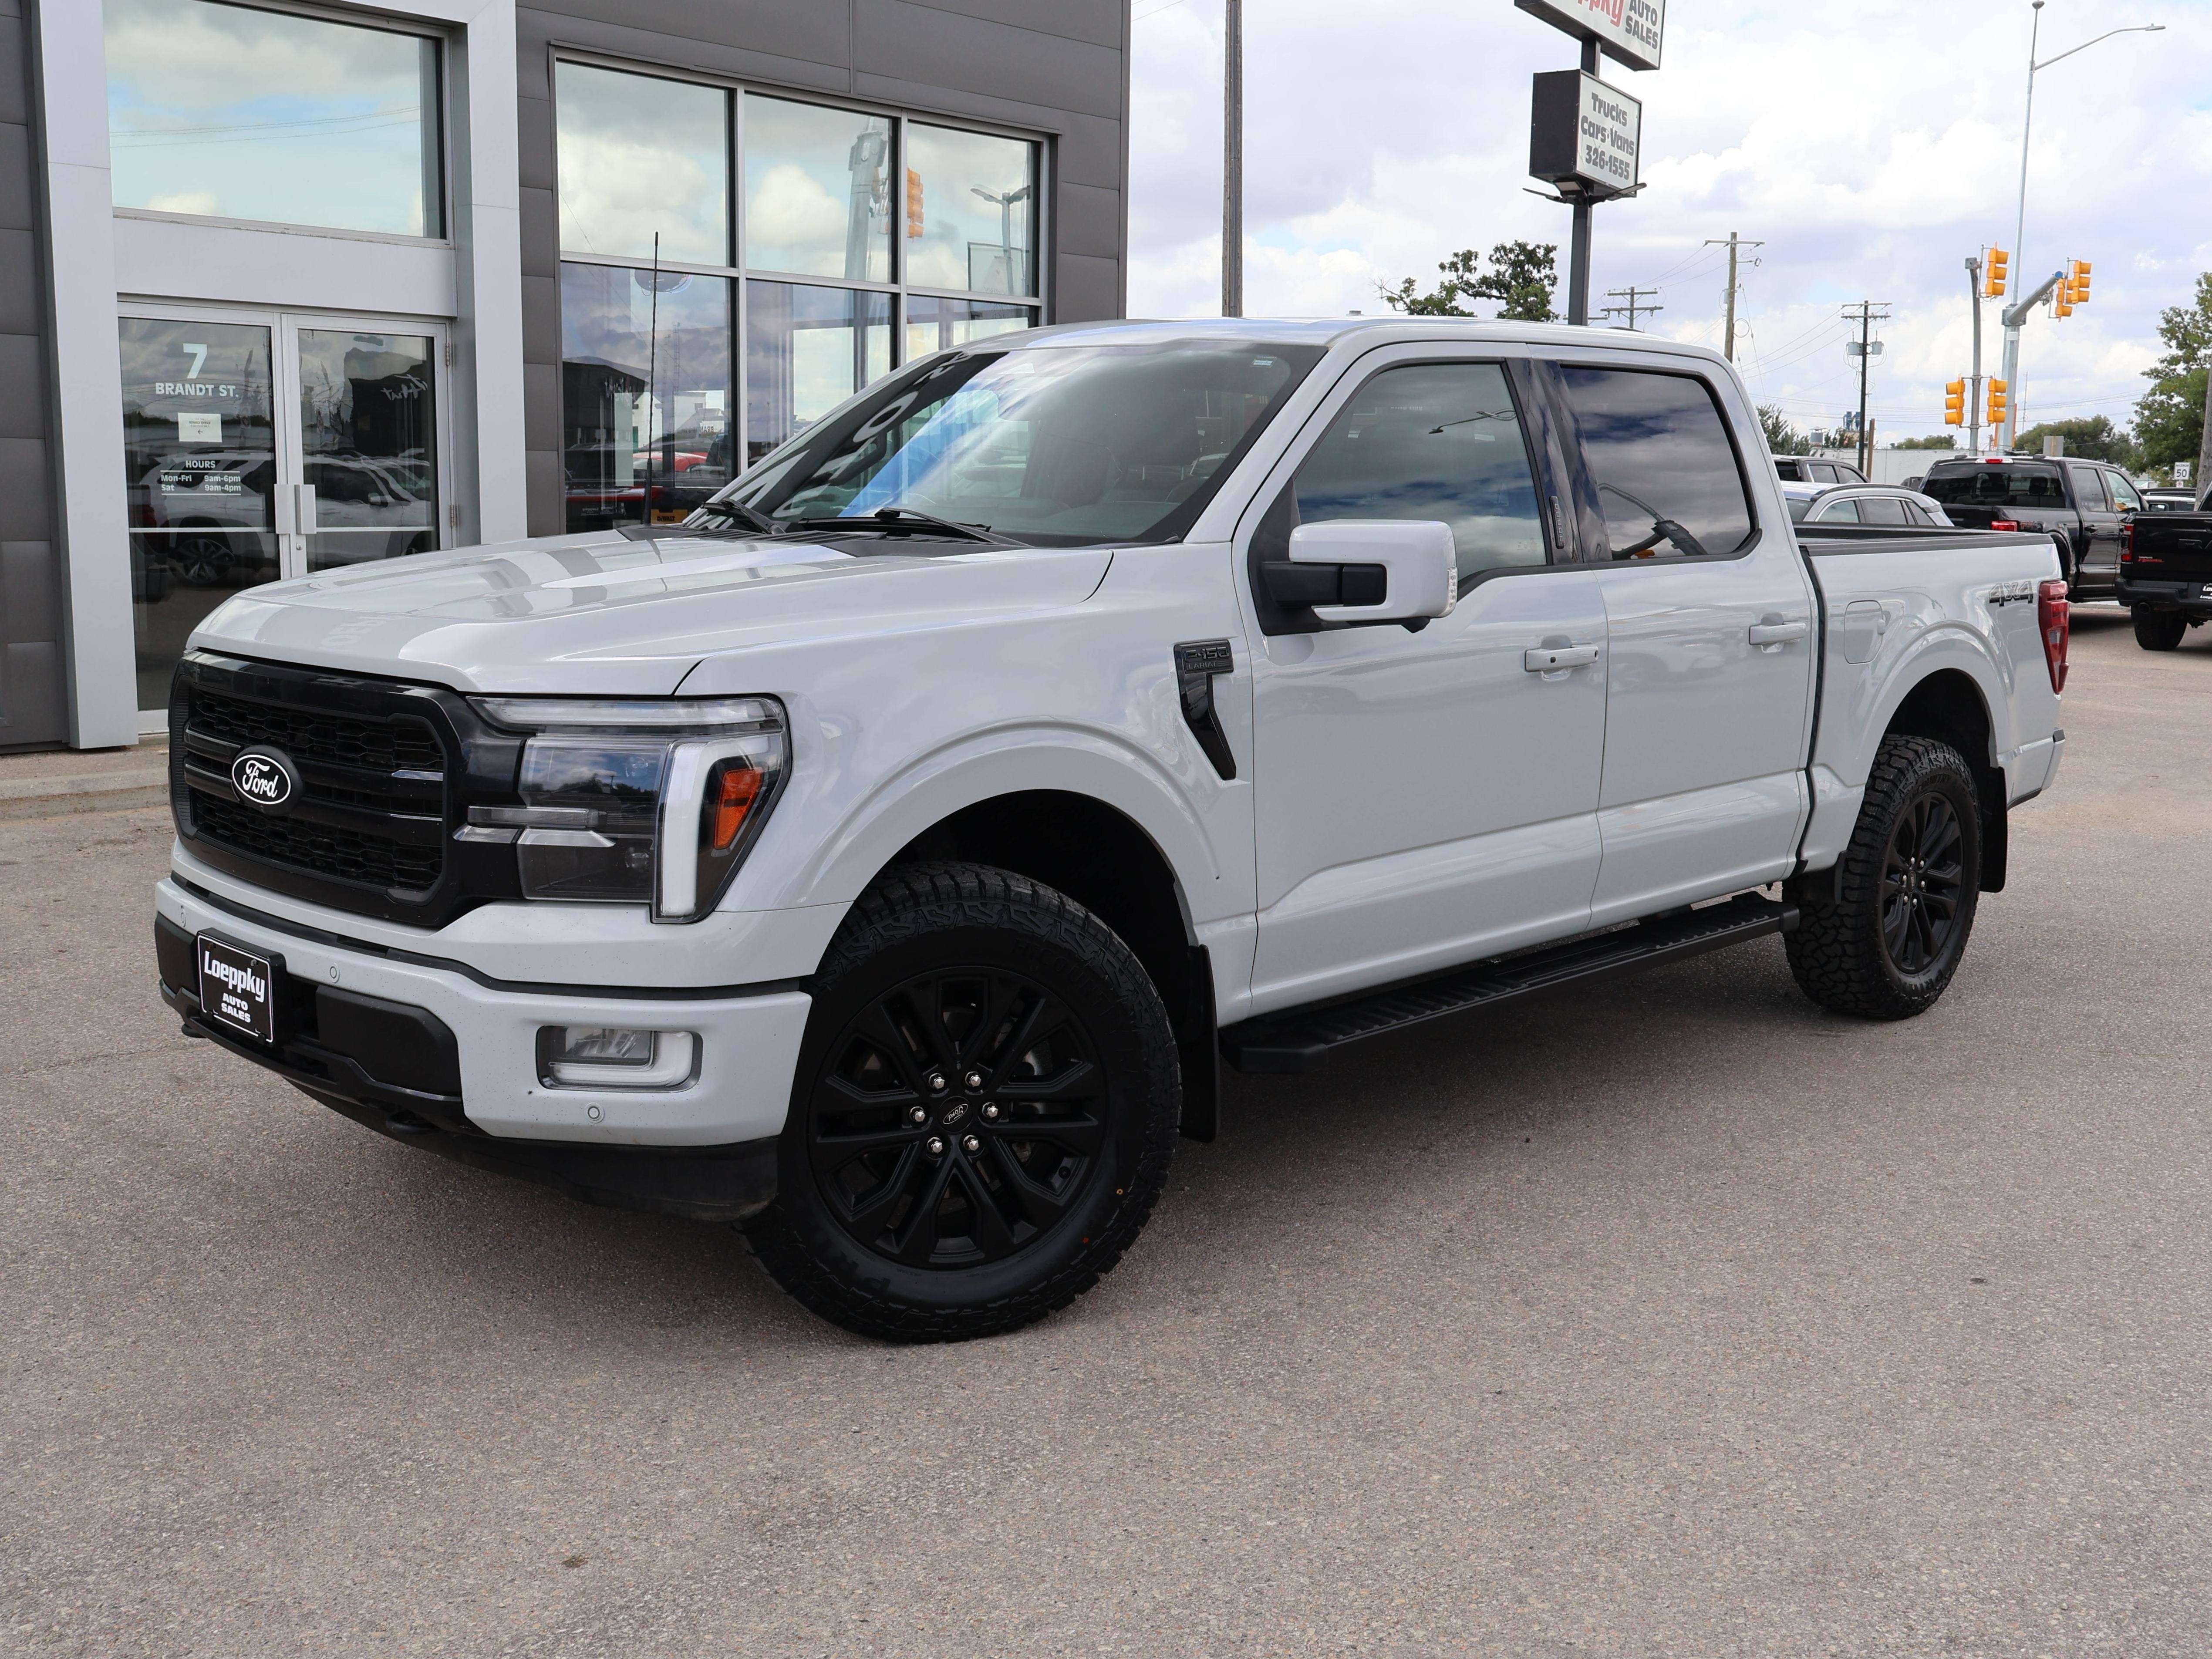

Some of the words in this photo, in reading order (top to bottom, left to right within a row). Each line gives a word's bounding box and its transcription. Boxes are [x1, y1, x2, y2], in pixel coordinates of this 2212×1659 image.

[1629, 0, 1658, 26] AUTO
[1625, 15, 1658, 50] SALES
[1592, 92, 1628, 127] Trucks
[1585, 144, 1630, 180] 326-1555
[183, 343, 208, 379] 7
[155, 382, 214, 396] BRANDT
[219, 384, 239, 398] ST.
[185, 460, 216, 469] HOURS
[2176, 469, 2187, 477] 50
[204, 484, 241, 492] 9am-4pm
[1188, 661, 1217, 670] LARIAT
[242, 760, 279, 798] Ford
[204, 951, 265, 1003] Loeppky
[221, 1003, 251, 1023] SALES
[222, 993, 248, 1011] AUTO
